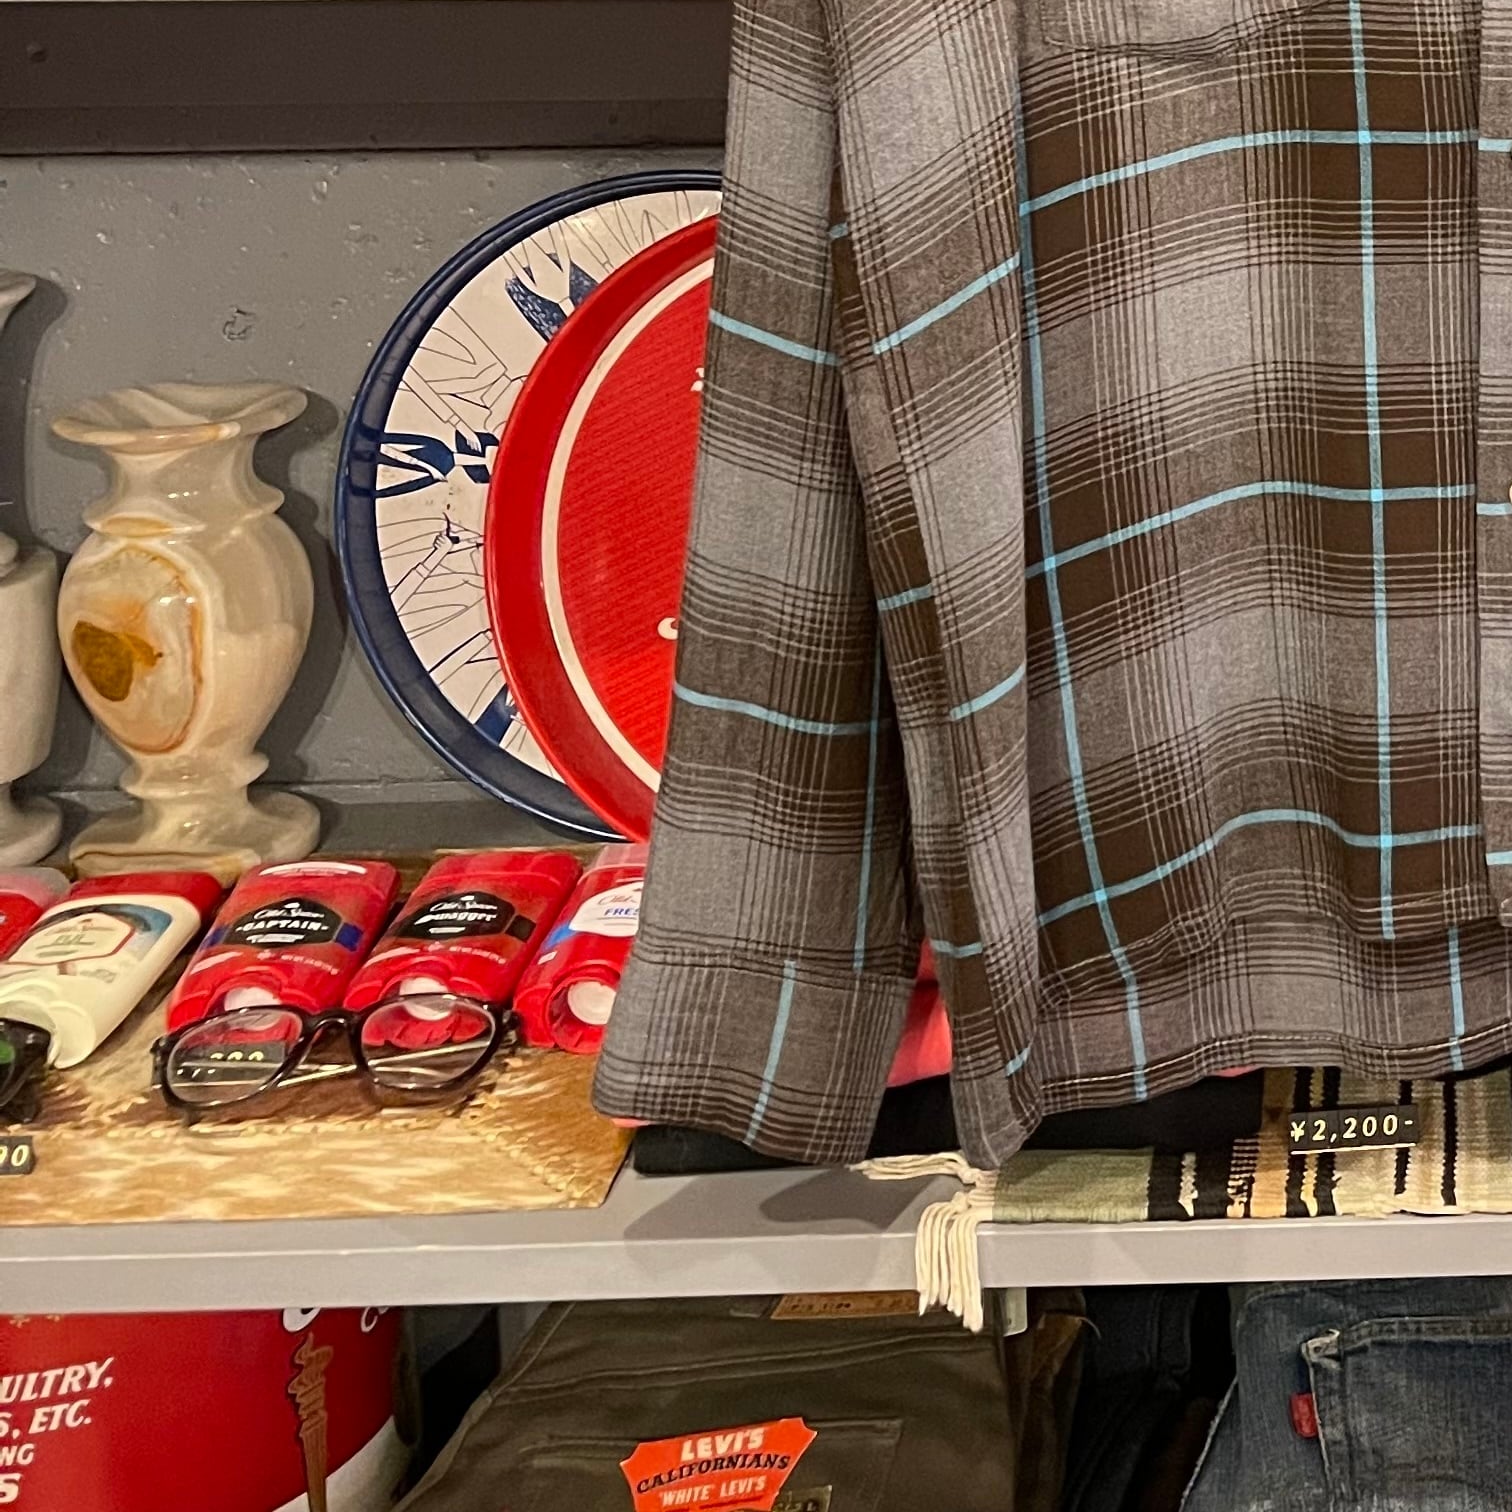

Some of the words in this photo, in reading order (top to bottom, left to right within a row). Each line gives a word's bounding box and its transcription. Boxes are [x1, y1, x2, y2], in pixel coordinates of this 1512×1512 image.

[28, 1399, 92, 1434] ETC.
[680, 1427, 767, 1461] LEVI'S
[636, 1452, 790, 1493] CALIFORNIANS
